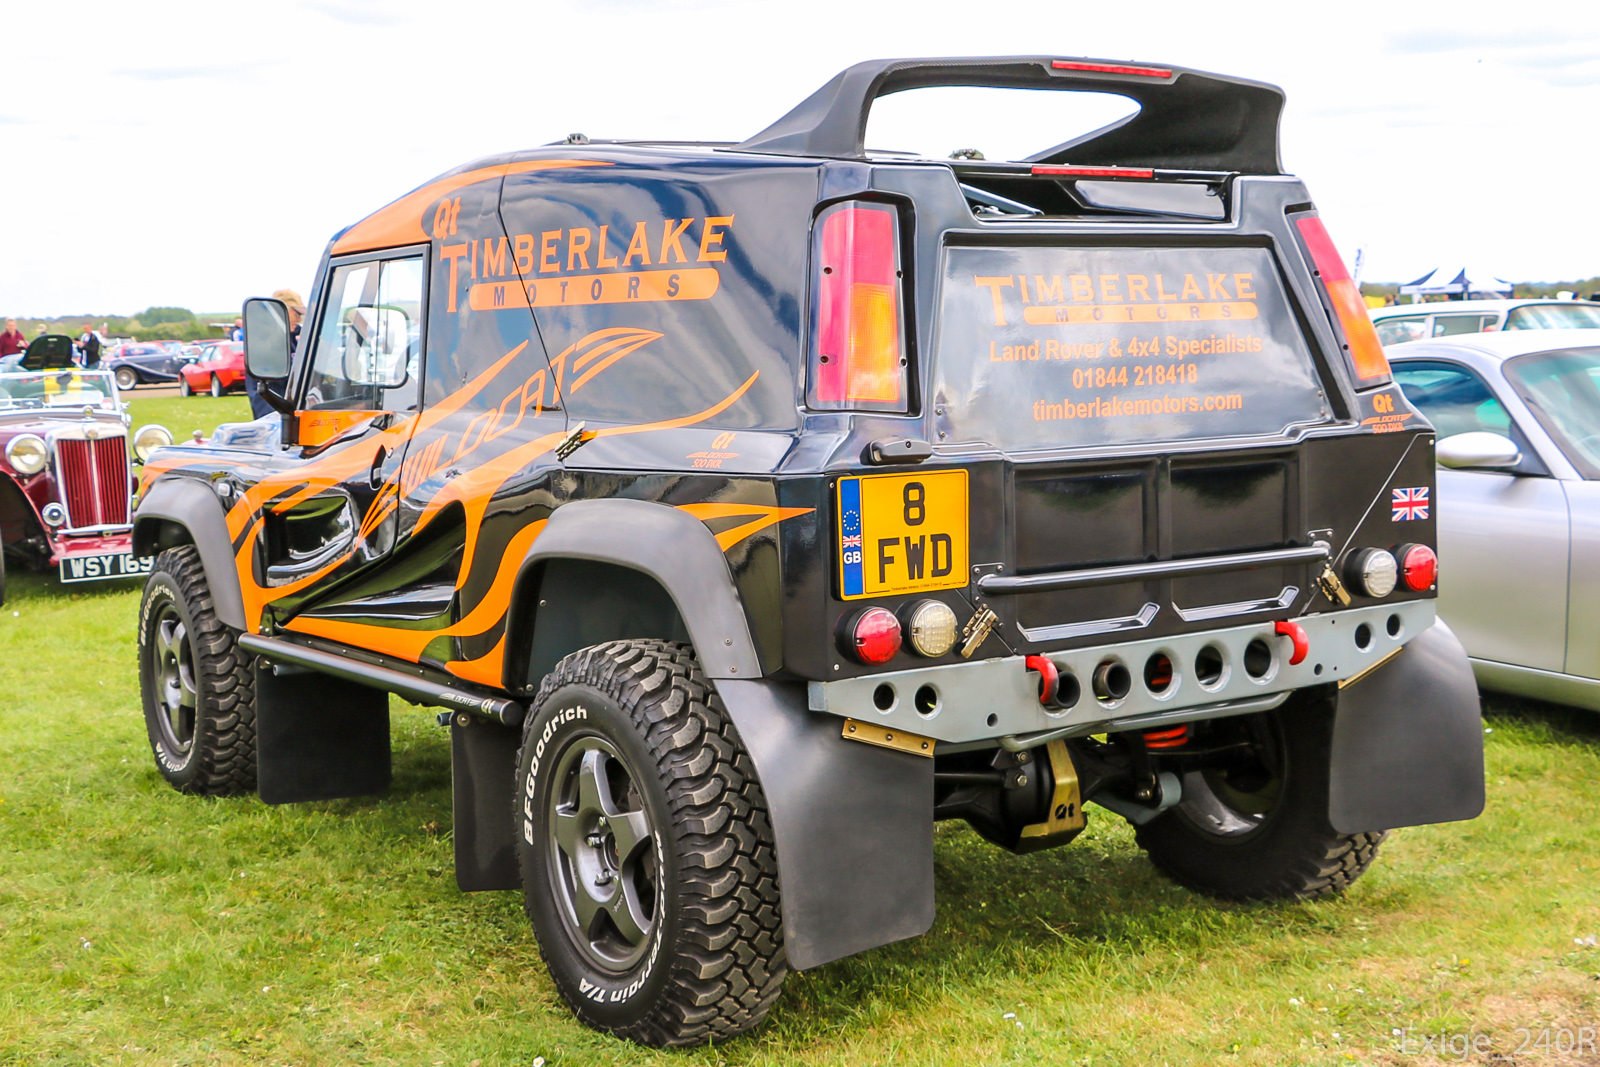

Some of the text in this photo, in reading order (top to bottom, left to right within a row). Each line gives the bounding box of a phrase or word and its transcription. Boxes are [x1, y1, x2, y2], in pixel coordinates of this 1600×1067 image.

[493, 273, 681, 306] MOTORS
[1055, 304, 1233, 323] MOTORS
[989, 333, 1264, 363] Land Rover & 4x4 Specialists
[1071, 362, 1199, 389] 01844 218418
[1032, 392, 1243, 422] timberlakemotors.com
[903, 482, 926, 527] 8
[70, 555, 114, 578] WSY
[843, 551, 862, 564] GB
[877, 532, 953, 584] FWD
[524, 705, 587, 846] BFGoodrich
[578, 977, 606, 1003] T/A
